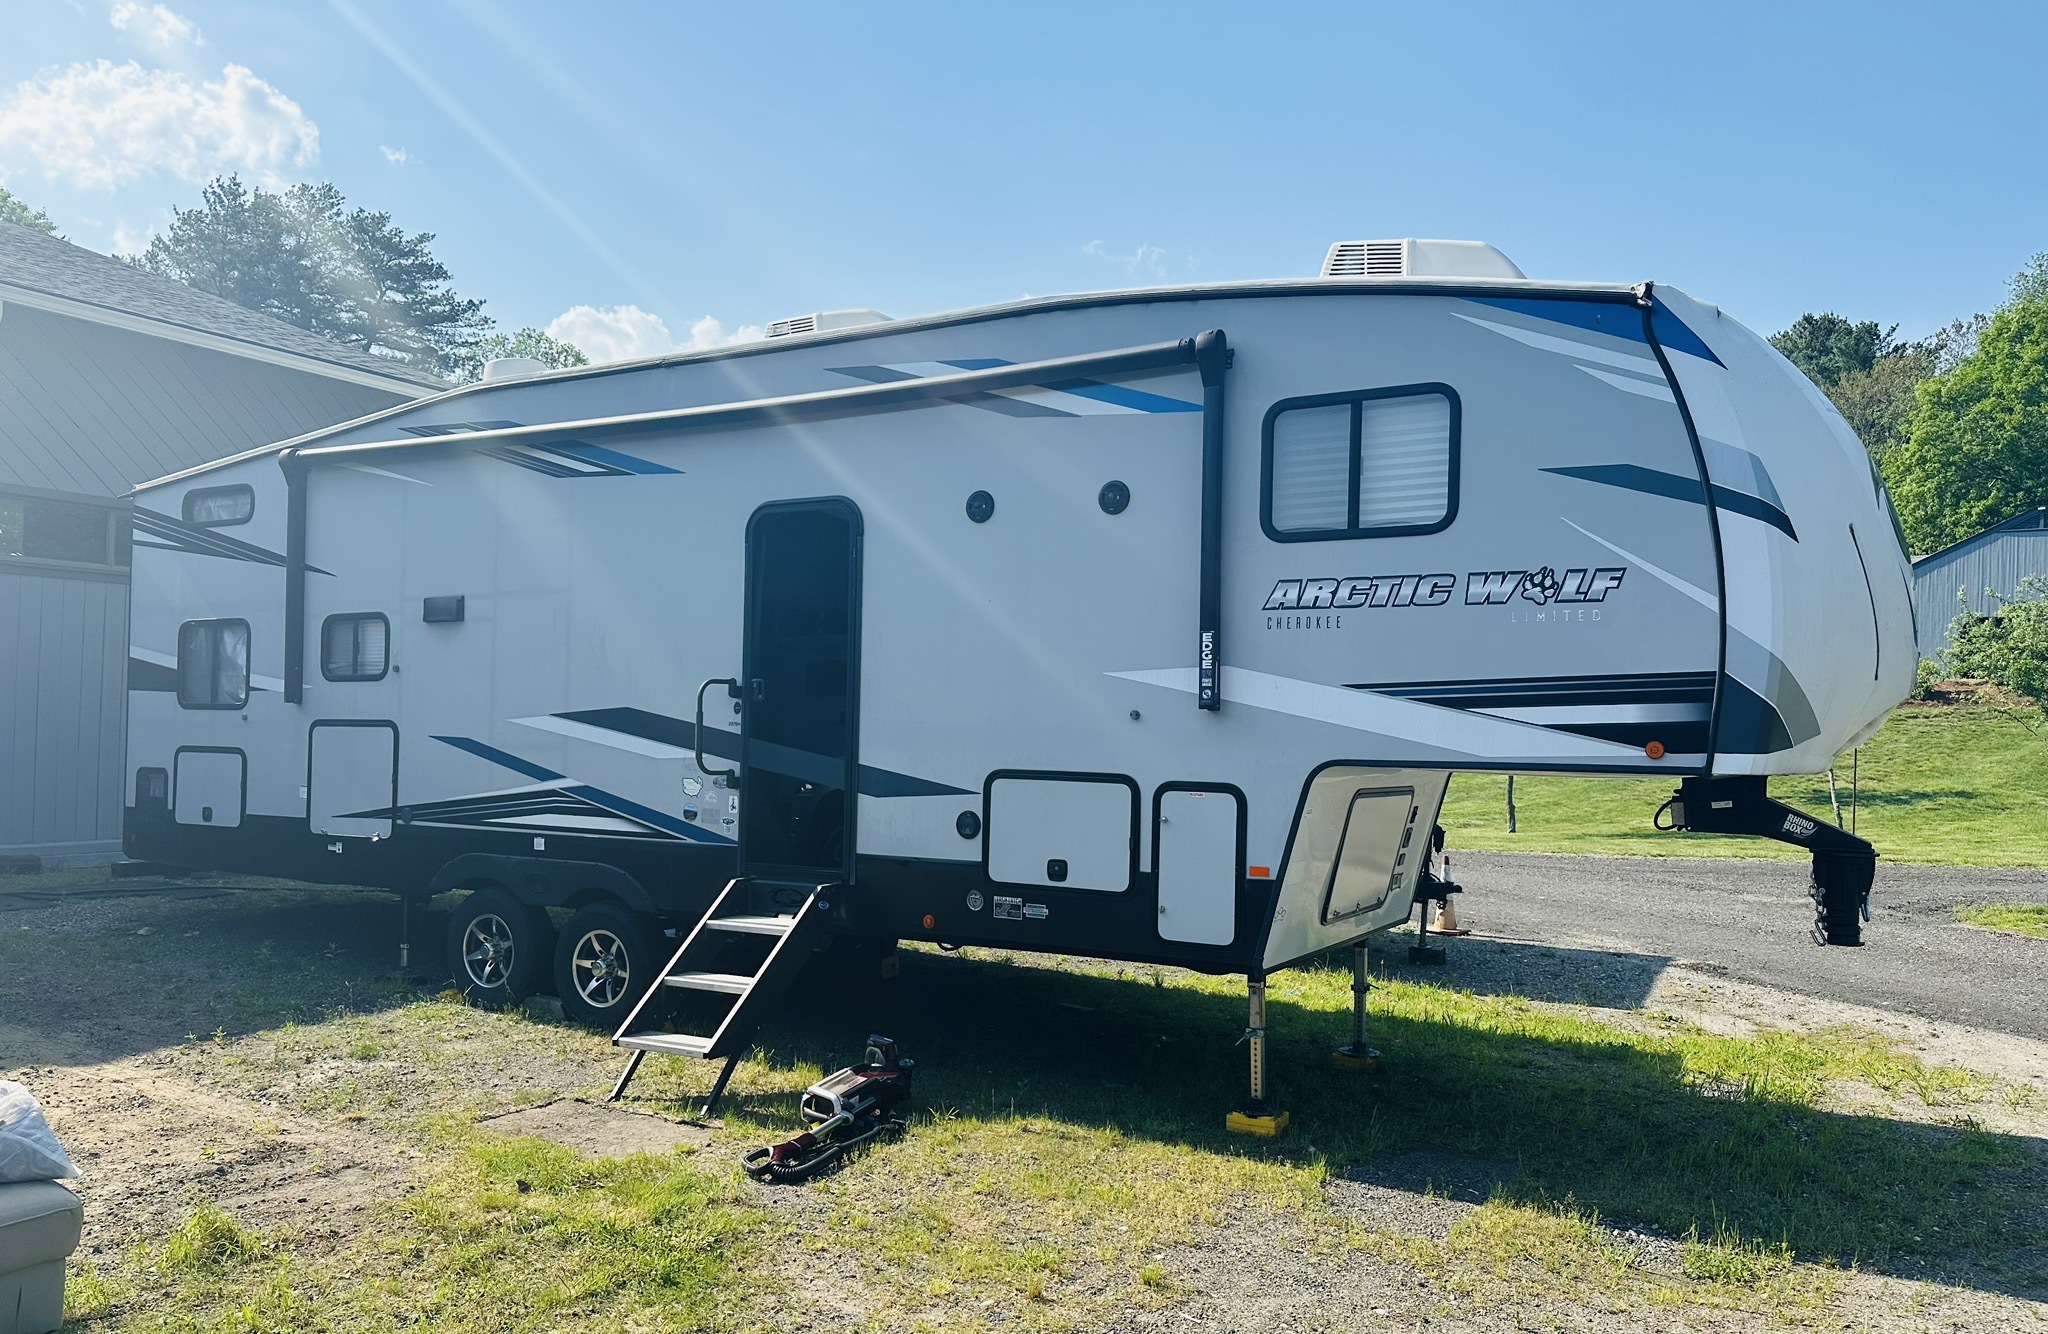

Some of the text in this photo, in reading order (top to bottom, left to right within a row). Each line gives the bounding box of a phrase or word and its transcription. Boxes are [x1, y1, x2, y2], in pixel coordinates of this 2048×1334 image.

[1262, 573, 1456, 611] ARCTIC
[1266, 615, 1342, 630] CHEROKEE
[1511, 609, 1601, 623] LIMITED
[1202, 632, 1213, 669] EDGE
[1783, 821, 1803, 834] BOX
[1786, 813, 1814, 830] RHINO
